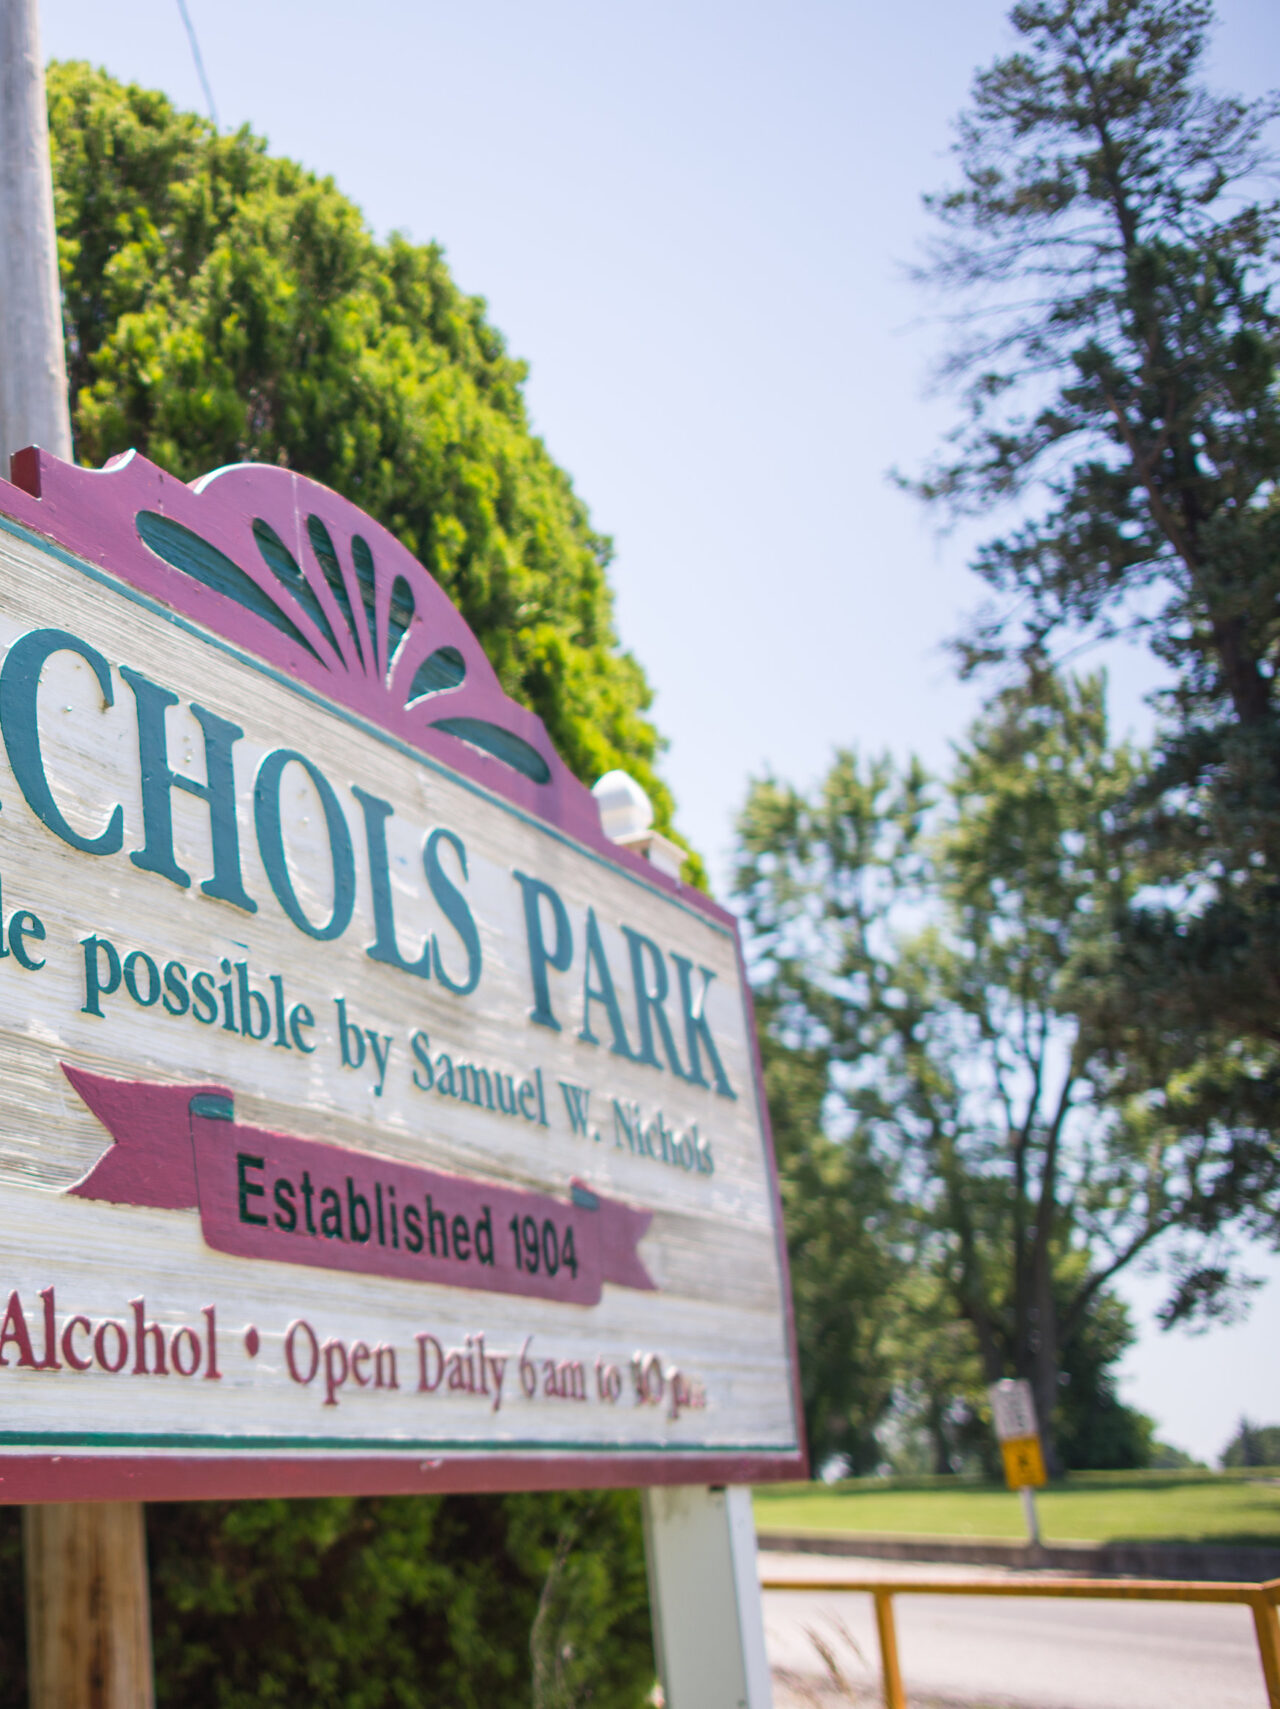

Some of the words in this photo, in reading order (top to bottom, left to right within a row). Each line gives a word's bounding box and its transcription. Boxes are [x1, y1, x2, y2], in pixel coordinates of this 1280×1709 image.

[79, 932, 317, 1054] possible
[334, 997, 393, 1097] by
[410, 1030, 550, 1128] Samuel
[558, 1080, 601, 1143] W.
[612, 1096, 715, 1175] Nichols
[512, 868, 738, 1100] PARK
[236, 1151, 496, 1267] Established
[509, 1212, 578, 1280] 1904
[284, 1318, 400, 1406] Open
[414, 1330, 508, 1413] Daily
[595, 1352, 622, 1404] to
